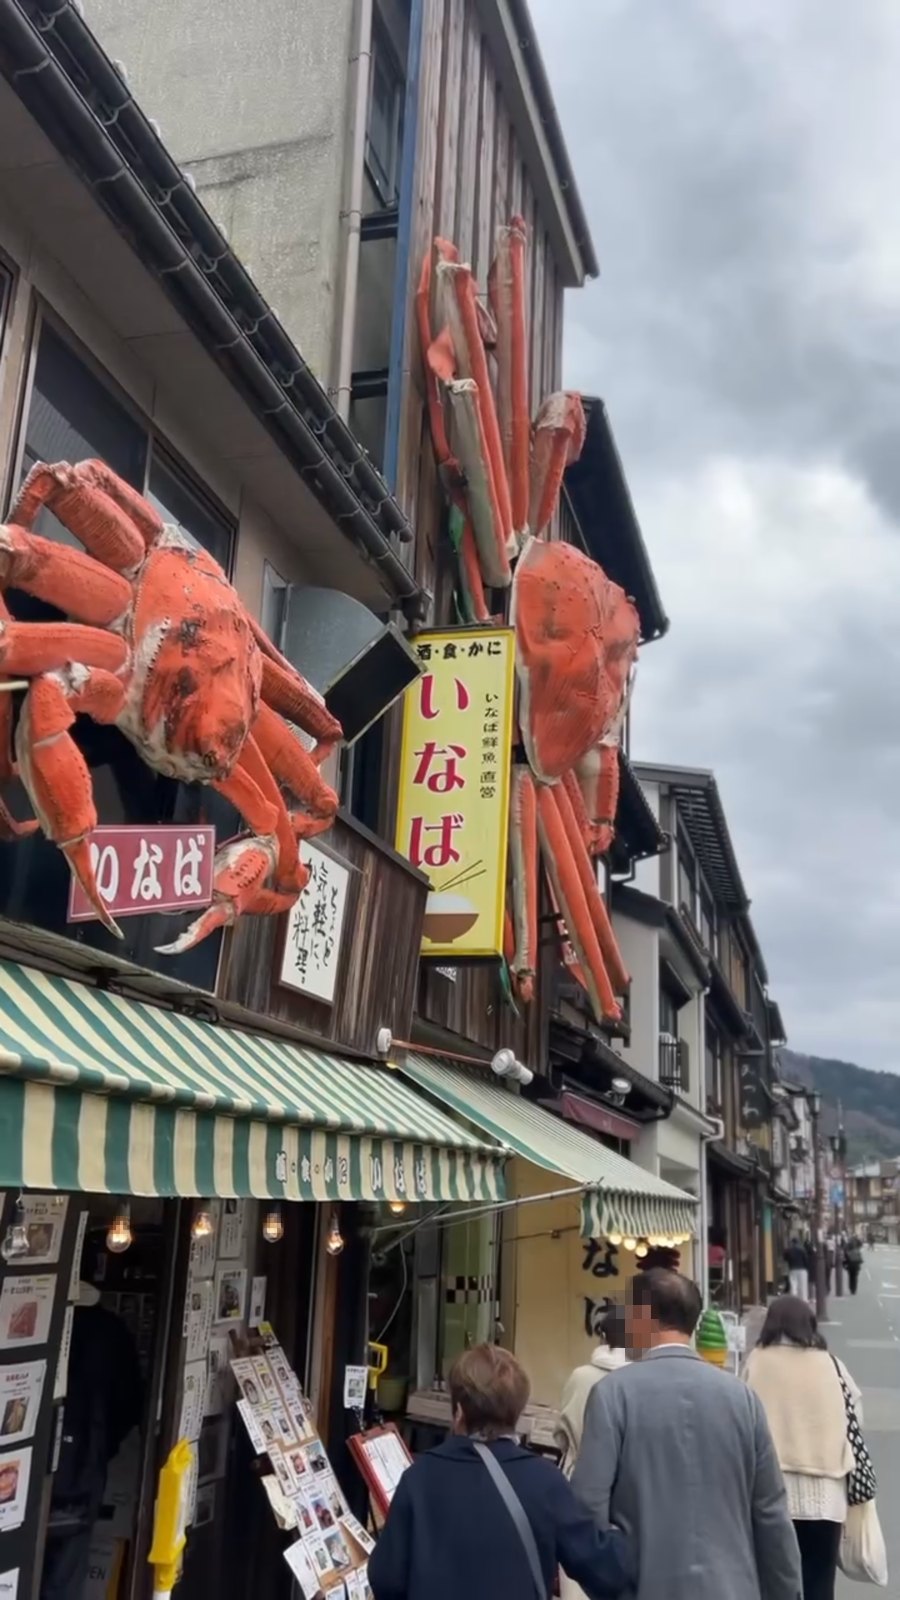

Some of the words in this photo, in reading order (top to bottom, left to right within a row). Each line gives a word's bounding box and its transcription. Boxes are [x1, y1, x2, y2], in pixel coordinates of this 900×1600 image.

[409, 674, 469, 867] いなば
[480, 692, 499, 800] いなば鮮魚直営
